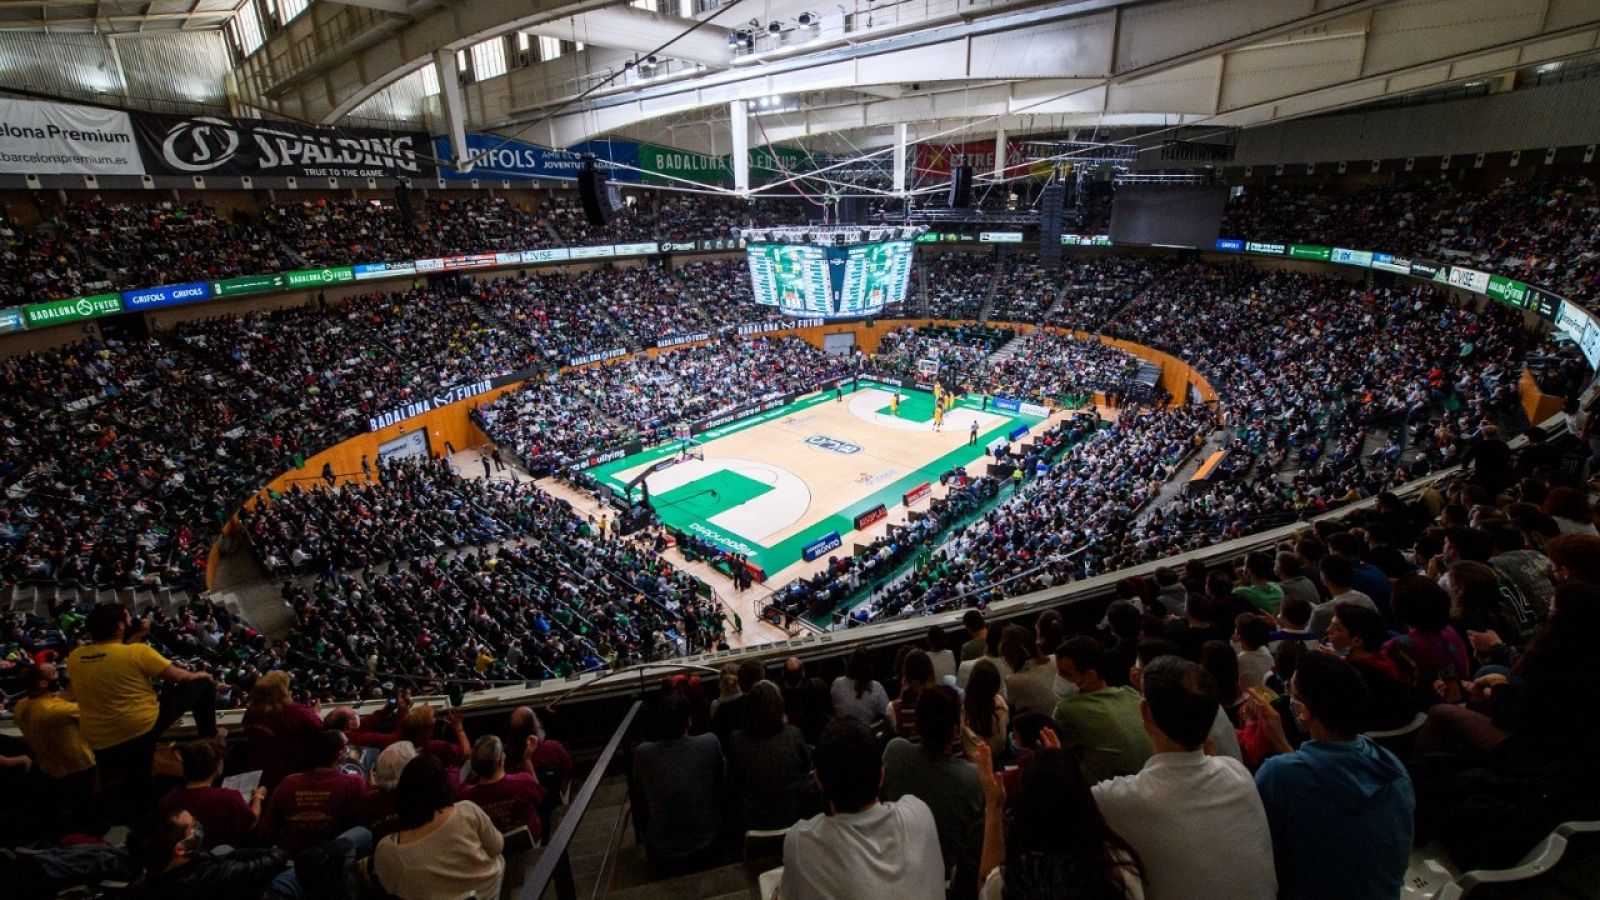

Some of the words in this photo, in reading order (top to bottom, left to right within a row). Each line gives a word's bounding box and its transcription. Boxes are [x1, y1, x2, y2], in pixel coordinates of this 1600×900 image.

[47, 124, 131, 145] Premium
[253, 128, 418, 173] SPALDING
[468, 147, 536, 170] RIFOLS
[543, 160, 586, 170] JOVENTUT
[656, 153, 727, 171] BADALONA
[303, 168, 328, 177] TRUE
[328, 168, 341, 177] TO
[342, 168, 359, 177] THE
[359, 168, 385, 178] GAME
[132, 293, 166, 305] GRIFOLS
[172, 287, 203, 299] GRIFOLS
[29, 304, 76, 322] BADALONA
[93, 299, 120, 313] FUTUR
[738, 322, 780, 337] BADALONA
[797, 318, 825, 330] FUTUR
[369, 400, 431, 432] BADALONA
[456, 379, 493, 402] FUTUR
[580, 459, 590, 470] el
[590, 449, 626, 467] bullying
